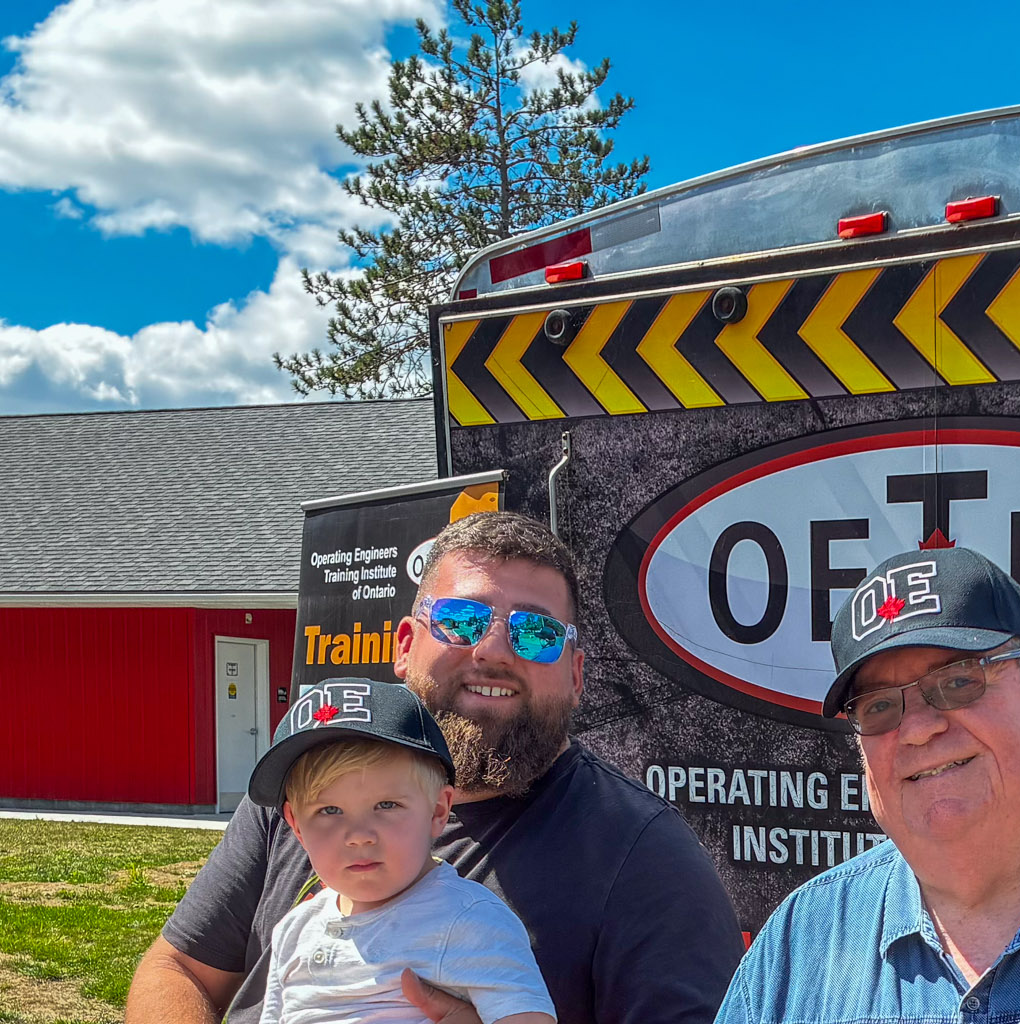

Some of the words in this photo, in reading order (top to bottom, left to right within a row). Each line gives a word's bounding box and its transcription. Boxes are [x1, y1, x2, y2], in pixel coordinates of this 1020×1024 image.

[311, 549, 352, 569] Operating
[354, 546, 398, 564] Engineers
[324, 568, 360, 584] Training
[361, 564, 397, 581] Institute
[352, 586, 363, 600] of
[363, 584, 396, 600] Ontario
[852, 561, 942, 641] OE
[304, 620, 399, 665] Traini
[291, 683, 371, 735] OE
[646, 765, 829, 810] OPERATING
